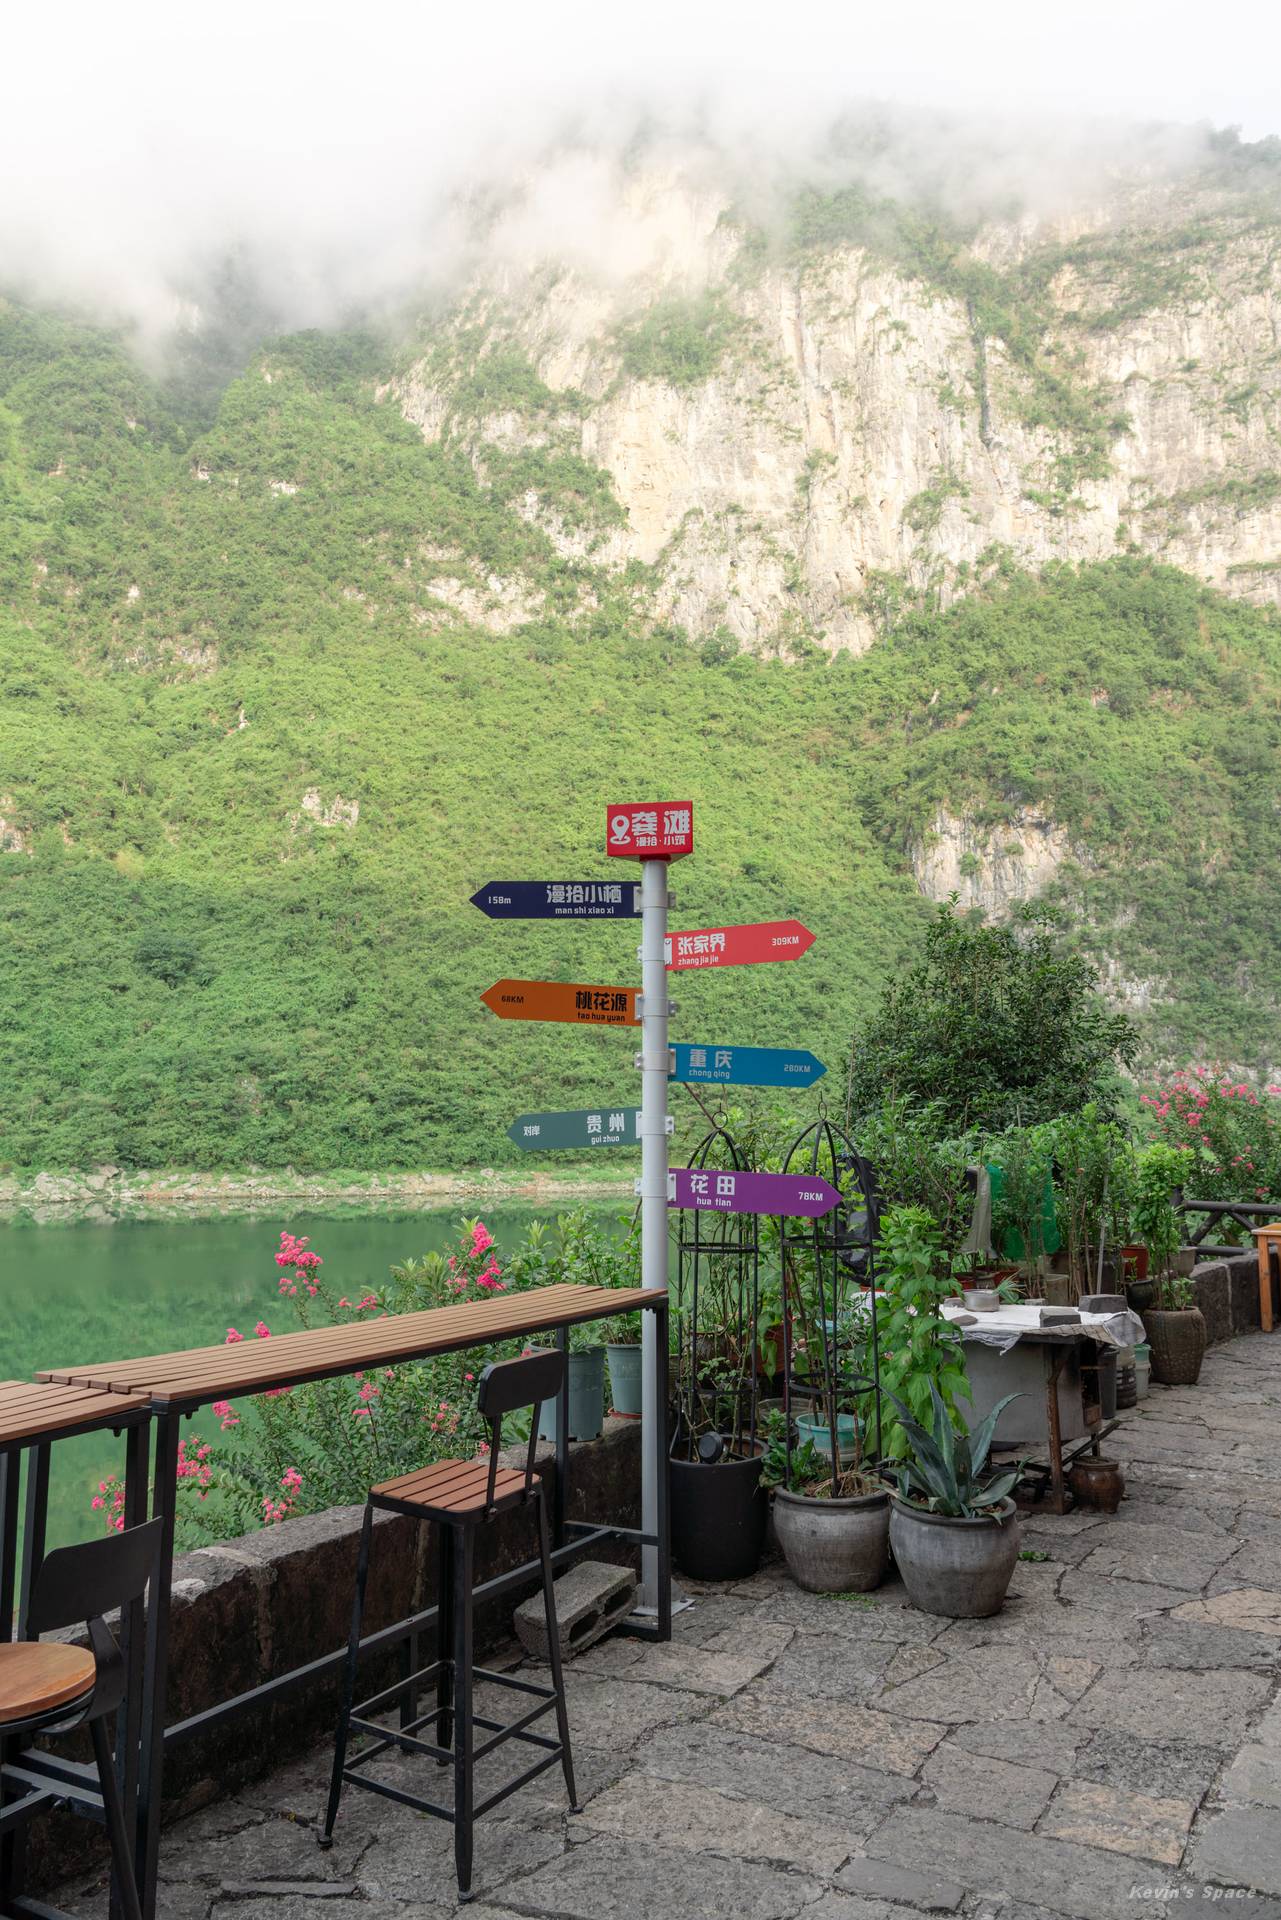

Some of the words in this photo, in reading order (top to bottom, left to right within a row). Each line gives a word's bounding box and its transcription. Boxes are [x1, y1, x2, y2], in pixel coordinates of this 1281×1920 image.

[632, 810, 690, 836] 龚滩
[547, 885, 622, 903] 漫拾小栖
[488, 896, 511, 904] 158m
[574, 906, 586, 914] shi
[588, 906, 605, 914] xiao
[607, 906, 614, 914] xi
[678, 932, 726, 955] 张家界
[772, 936, 799, 946] 309KM
[678, 957, 699, 966] zhang
[699, 956, 709, 965] jia
[710, 955, 718, 964] jie
[501, 995, 524, 1003] 68KM
[576, 990, 628, 1012] 桃花源
[578, 1012, 590, 1020] tao
[689, 1049, 732, 1069] 重庆
[784, 1064, 810, 1072] 280KM
[689, 1069, 712, 1078] chong
[714, 1071, 730, 1079] qing
[587, 1113, 625, 1133] 贵州
[523, 1125, 540, 1136] 对岸
[591, 1136, 601, 1145] gui
[690, 1174, 736, 1196] 花田
[696, 1197, 712, 1206] hua
[715, 1198, 732, 1206] tian
[798, 1192, 823, 1201] 78KM
